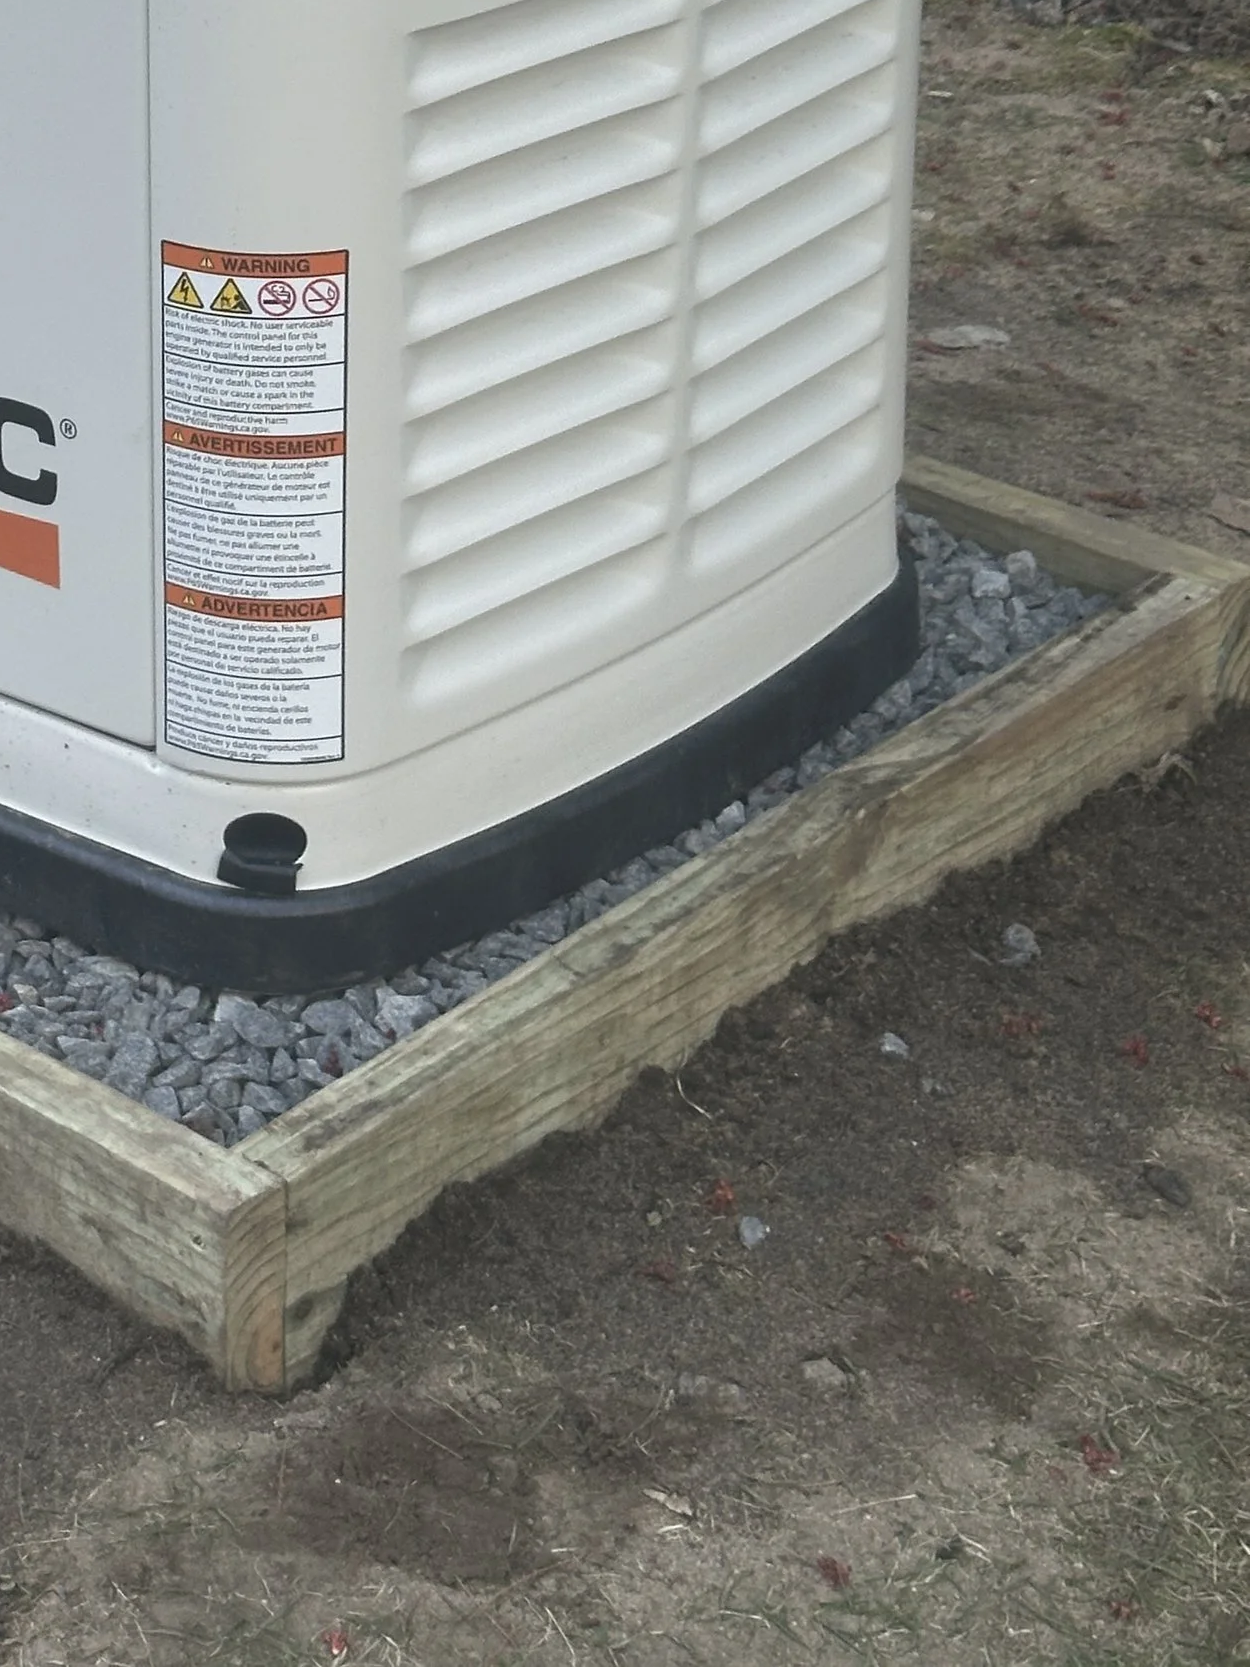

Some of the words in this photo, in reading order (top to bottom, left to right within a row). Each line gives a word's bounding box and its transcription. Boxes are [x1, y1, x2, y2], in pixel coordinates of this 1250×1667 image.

[221, 257, 311, 273] WARNING
[181, 312, 189, 320] of
[286, 319, 333, 329] serviceable
[166, 318, 184, 332] parts
[212, 329, 227, 337] The
[229, 331, 260, 340] control
[262, 333, 286, 342] panel
[288, 332, 300, 340] for
[302, 331, 317, 339] this
[234, 342, 241, 350] is
[243, 343, 282, 351] intended
[295, 343, 313, 353] only
[316, 342, 326, 350] be
[200, 348, 210, 359] by
[212, 350, 249, 363] qualified
[251, 354, 281, 362] service
[203, 364, 211, 372] of
[213, 366, 242, 378] battery
[245, 371, 269, 379] gases
[225, 378, 252, 388] death.
[193, 394, 201, 403] of
[219, 399, 249, 411] battery
[264, 392, 286, 401] spark
[189, 433, 338, 456] AVERTISSEMENT
[306, 460, 329, 470] pièce
[285, 483, 316, 491] moteur
[299, 495, 313, 503] par
[237, 518, 248, 526] de
[201, 596, 328, 618] ADVERTENCIA
[295, 624, 311, 634] hay
[257, 646, 300, 655] generador
[315, 643, 340, 652] motor
